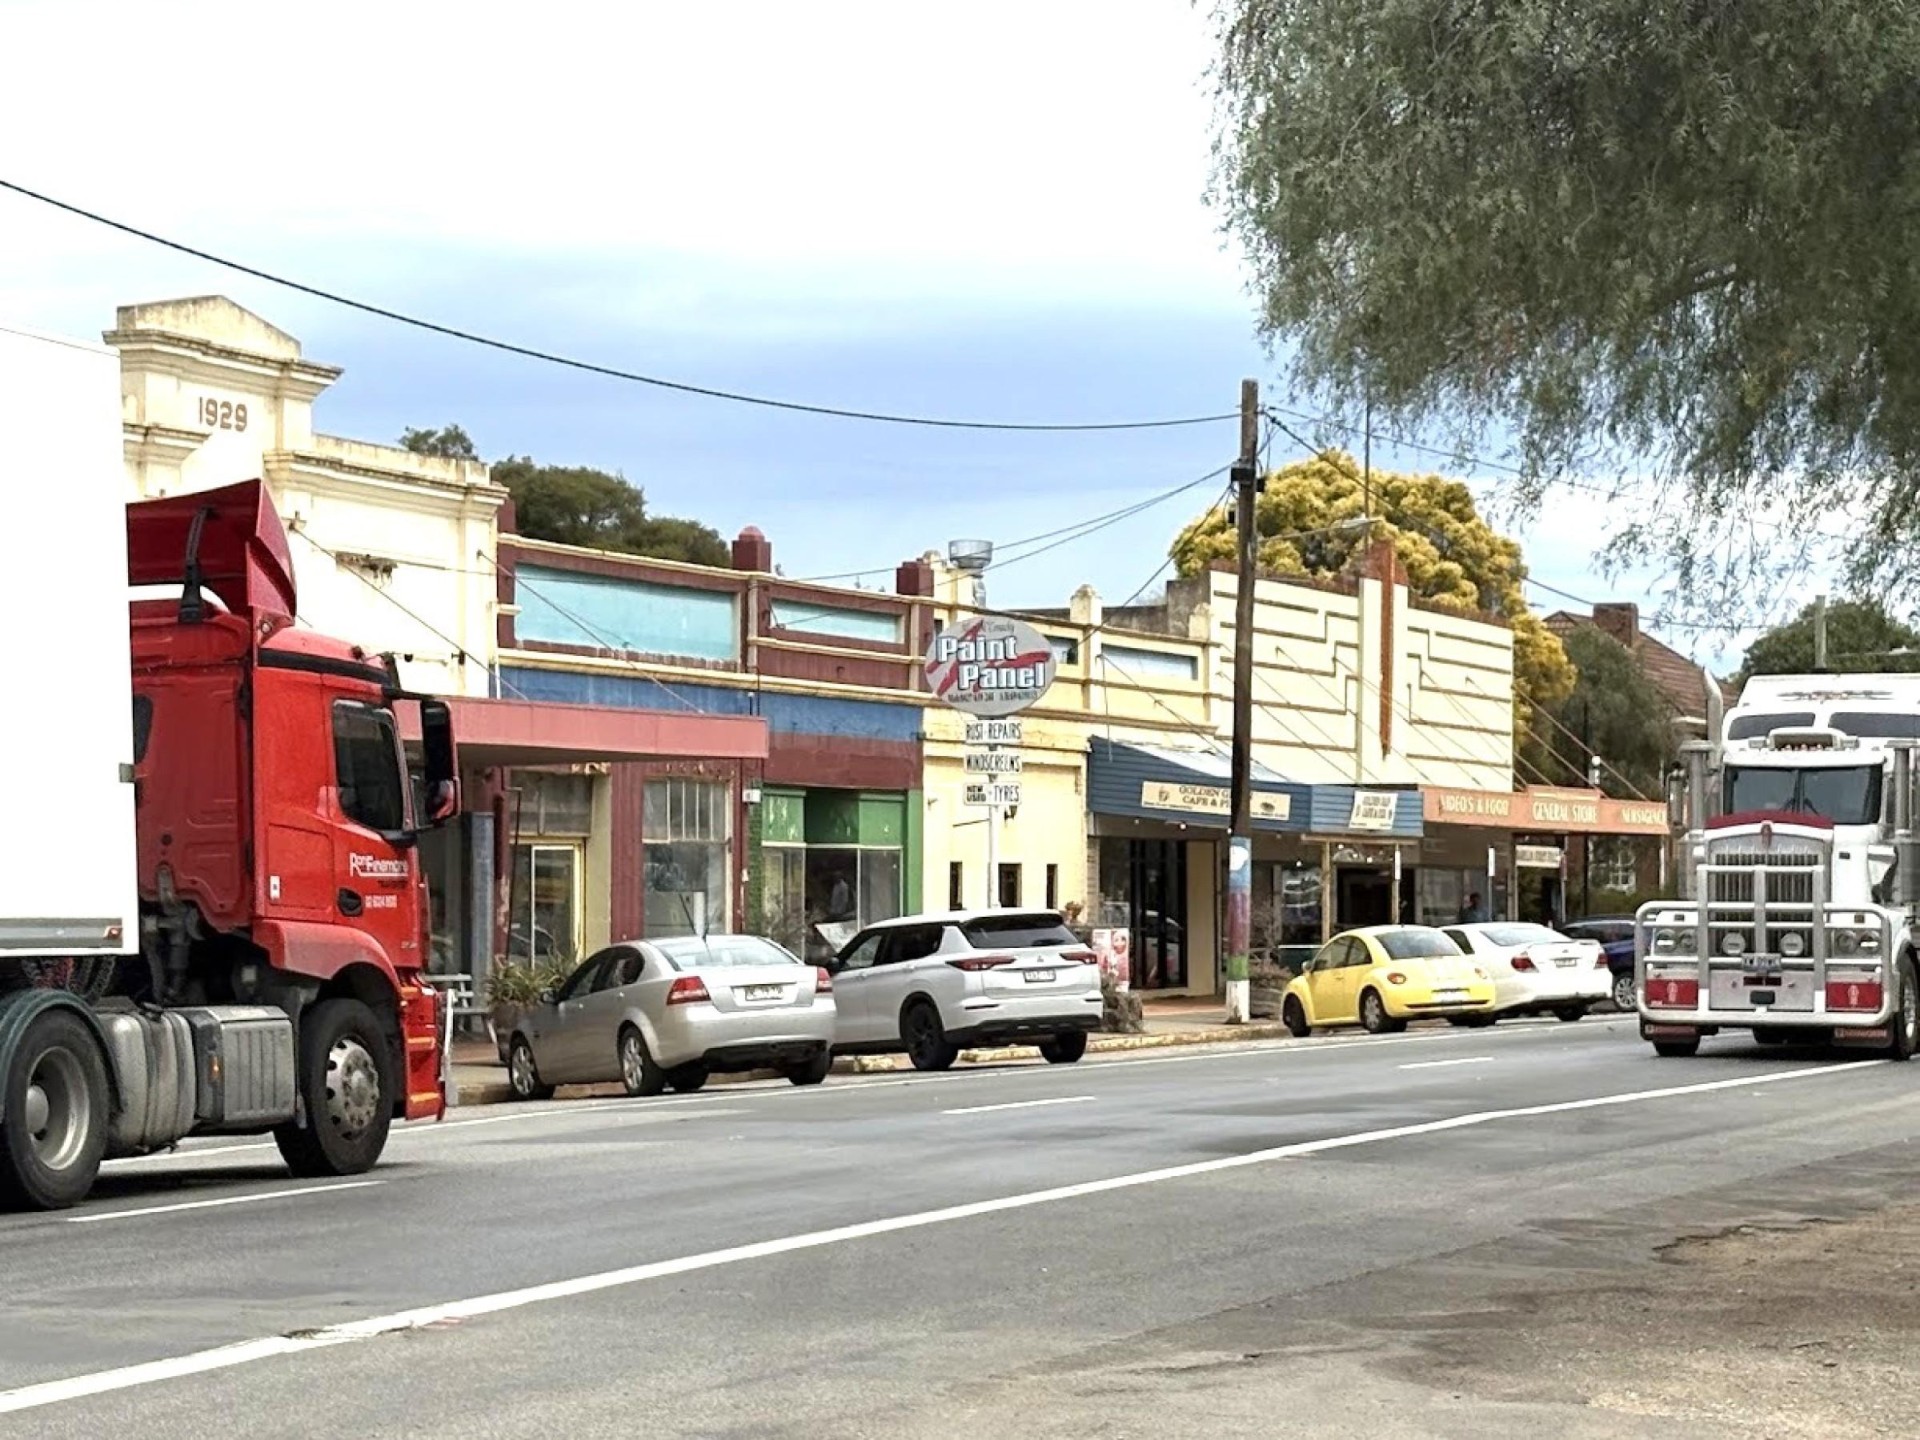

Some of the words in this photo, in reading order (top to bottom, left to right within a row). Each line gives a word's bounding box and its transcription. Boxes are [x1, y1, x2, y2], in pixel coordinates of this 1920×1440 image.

[197, 396, 248, 432] 1929
[936, 635, 1018, 663] Paint
[957, 662, 1047, 691] Panel
[988, 722, 1023, 740] REPAIRS
[966, 754, 1021, 773] WINDSCREENS
[994, 785, 1020, 802] TYRES
[1178, 785, 1220, 797] GOLDEN
[1210, 797, 1218, 807] &
[1532, 801, 1569, 822] GENERAL
[1572, 804, 1598, 824] STORE
